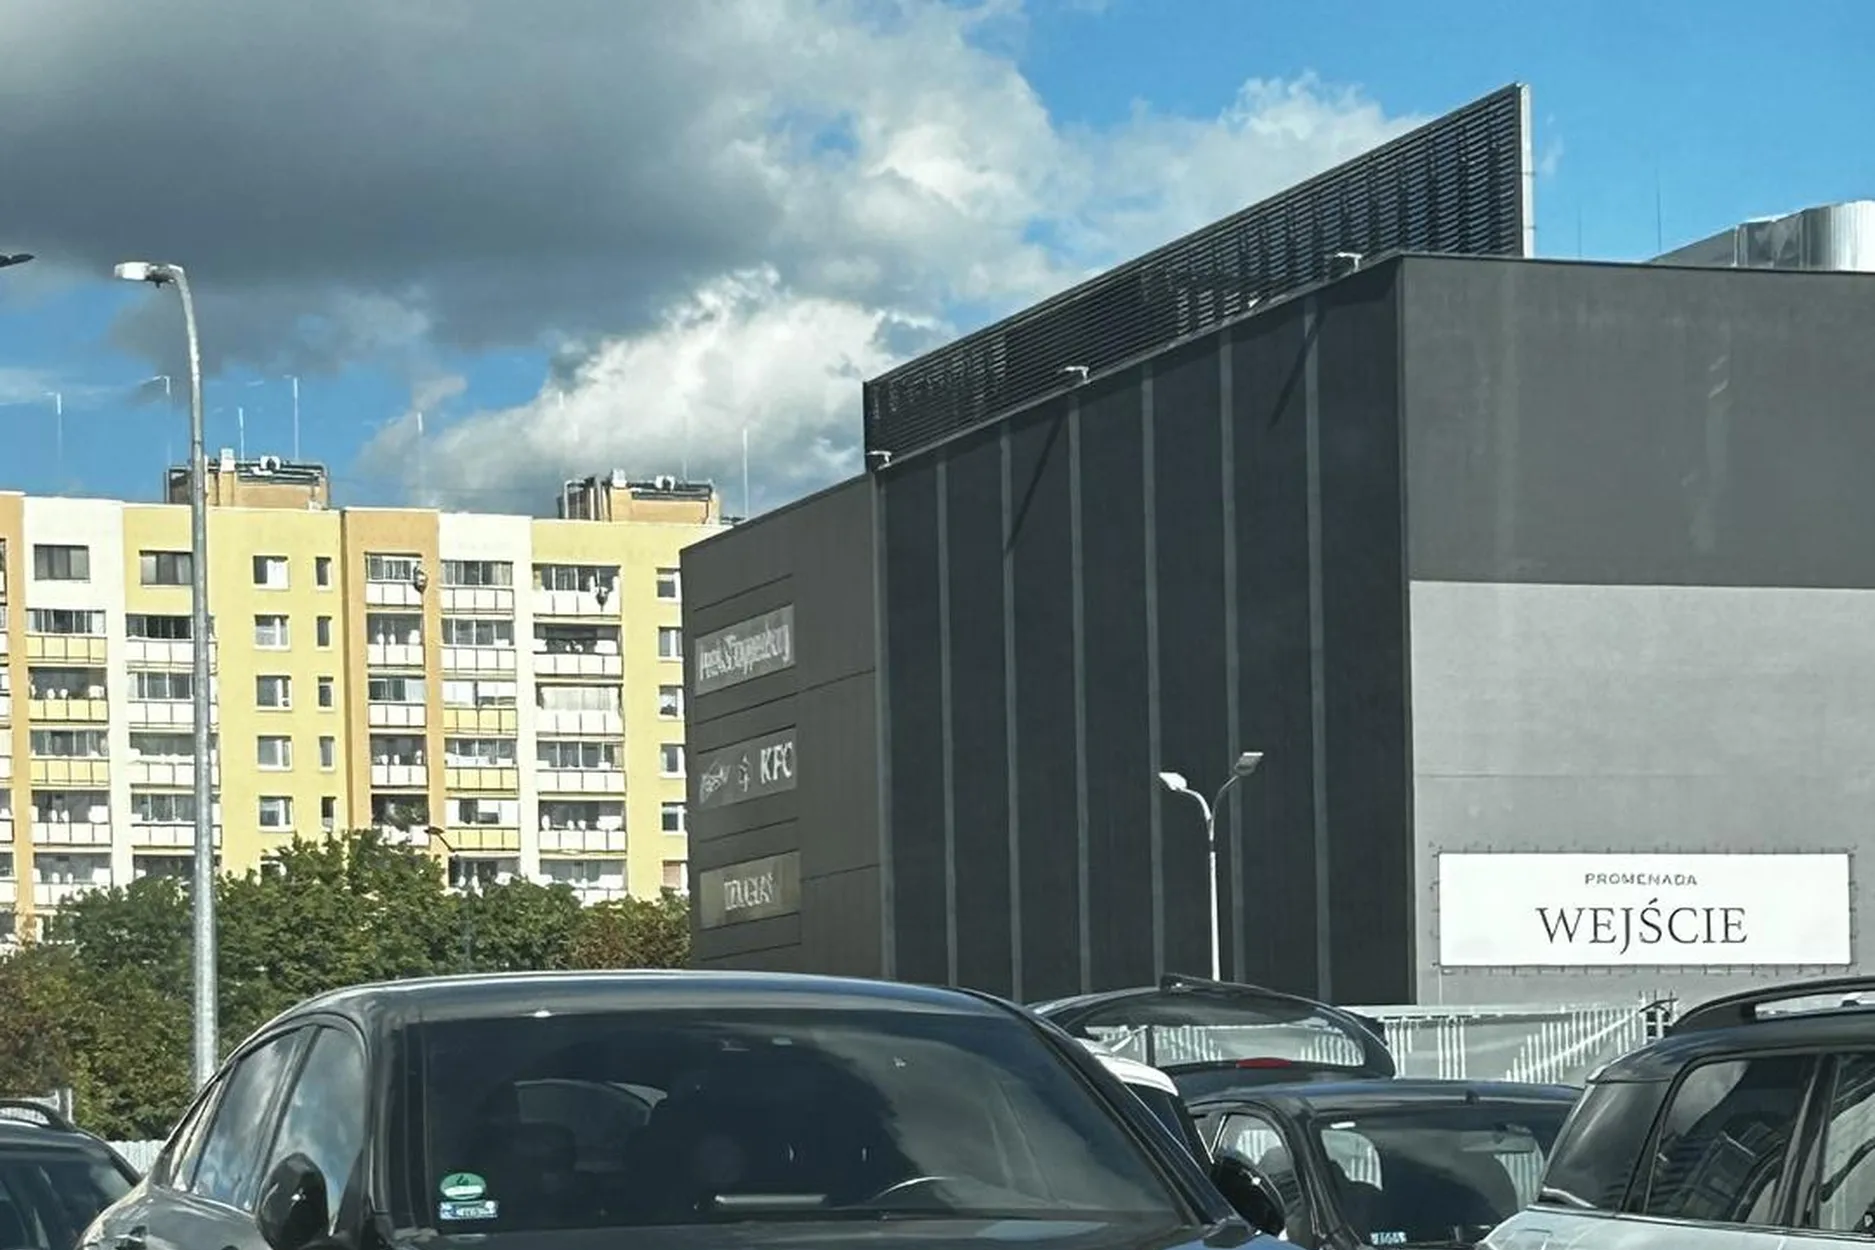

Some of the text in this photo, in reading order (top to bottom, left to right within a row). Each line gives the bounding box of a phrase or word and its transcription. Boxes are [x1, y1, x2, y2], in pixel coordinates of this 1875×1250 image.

[761, 741, 792, 784] KFC
[1584, 873, 1698, 886] PROMENADA
[1535, 897, 1748, 955] WEJŚCIE
